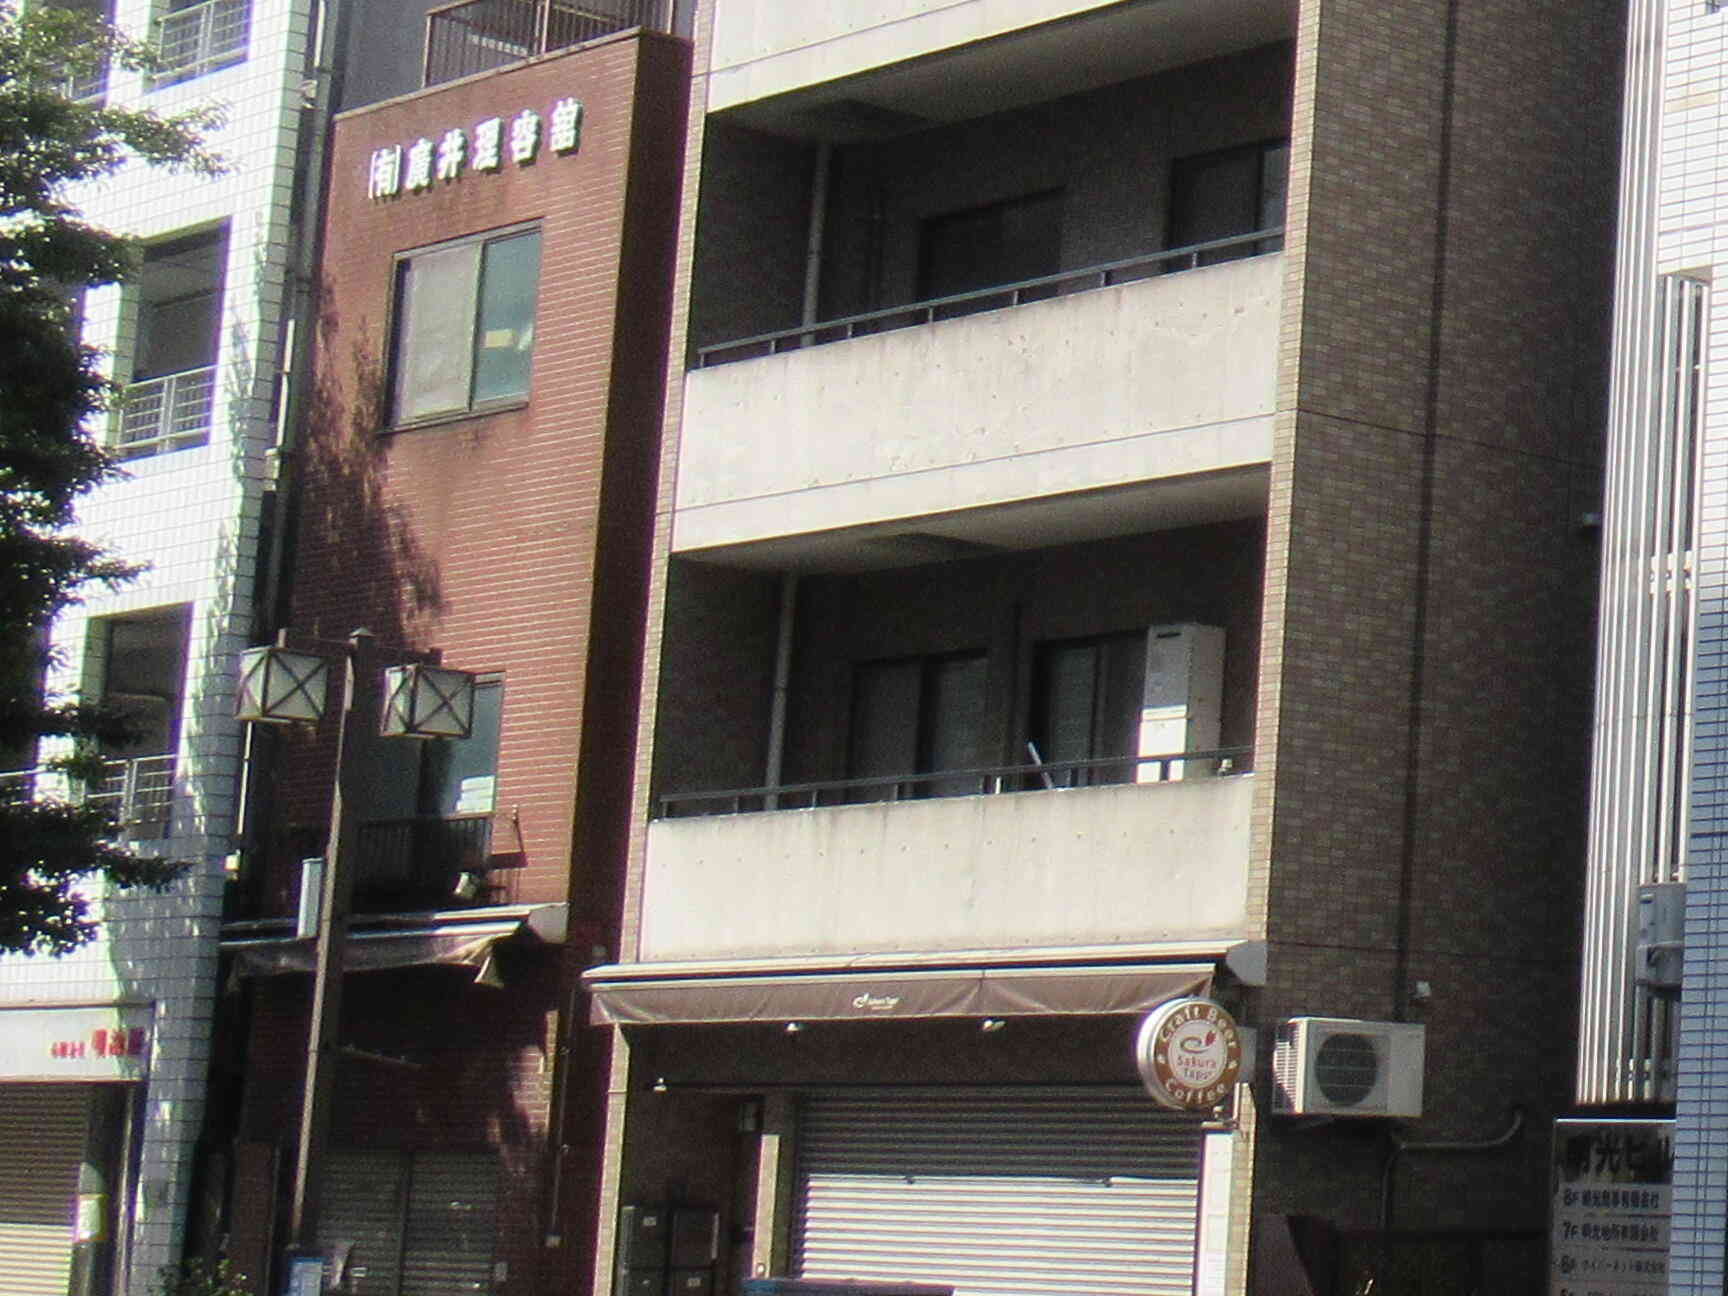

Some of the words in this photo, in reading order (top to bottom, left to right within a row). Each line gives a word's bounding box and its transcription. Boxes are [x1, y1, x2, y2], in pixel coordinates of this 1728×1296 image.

[1160, 1005, 1201, 1042] Craft
[1207, 1007, 1238, 1047] Beer
[1177, 1055, 1217, 1070] Sakura
[1166, 1079, 1226, 1103] Coffee
[1563, 1222, 1579, 1241] 7F
